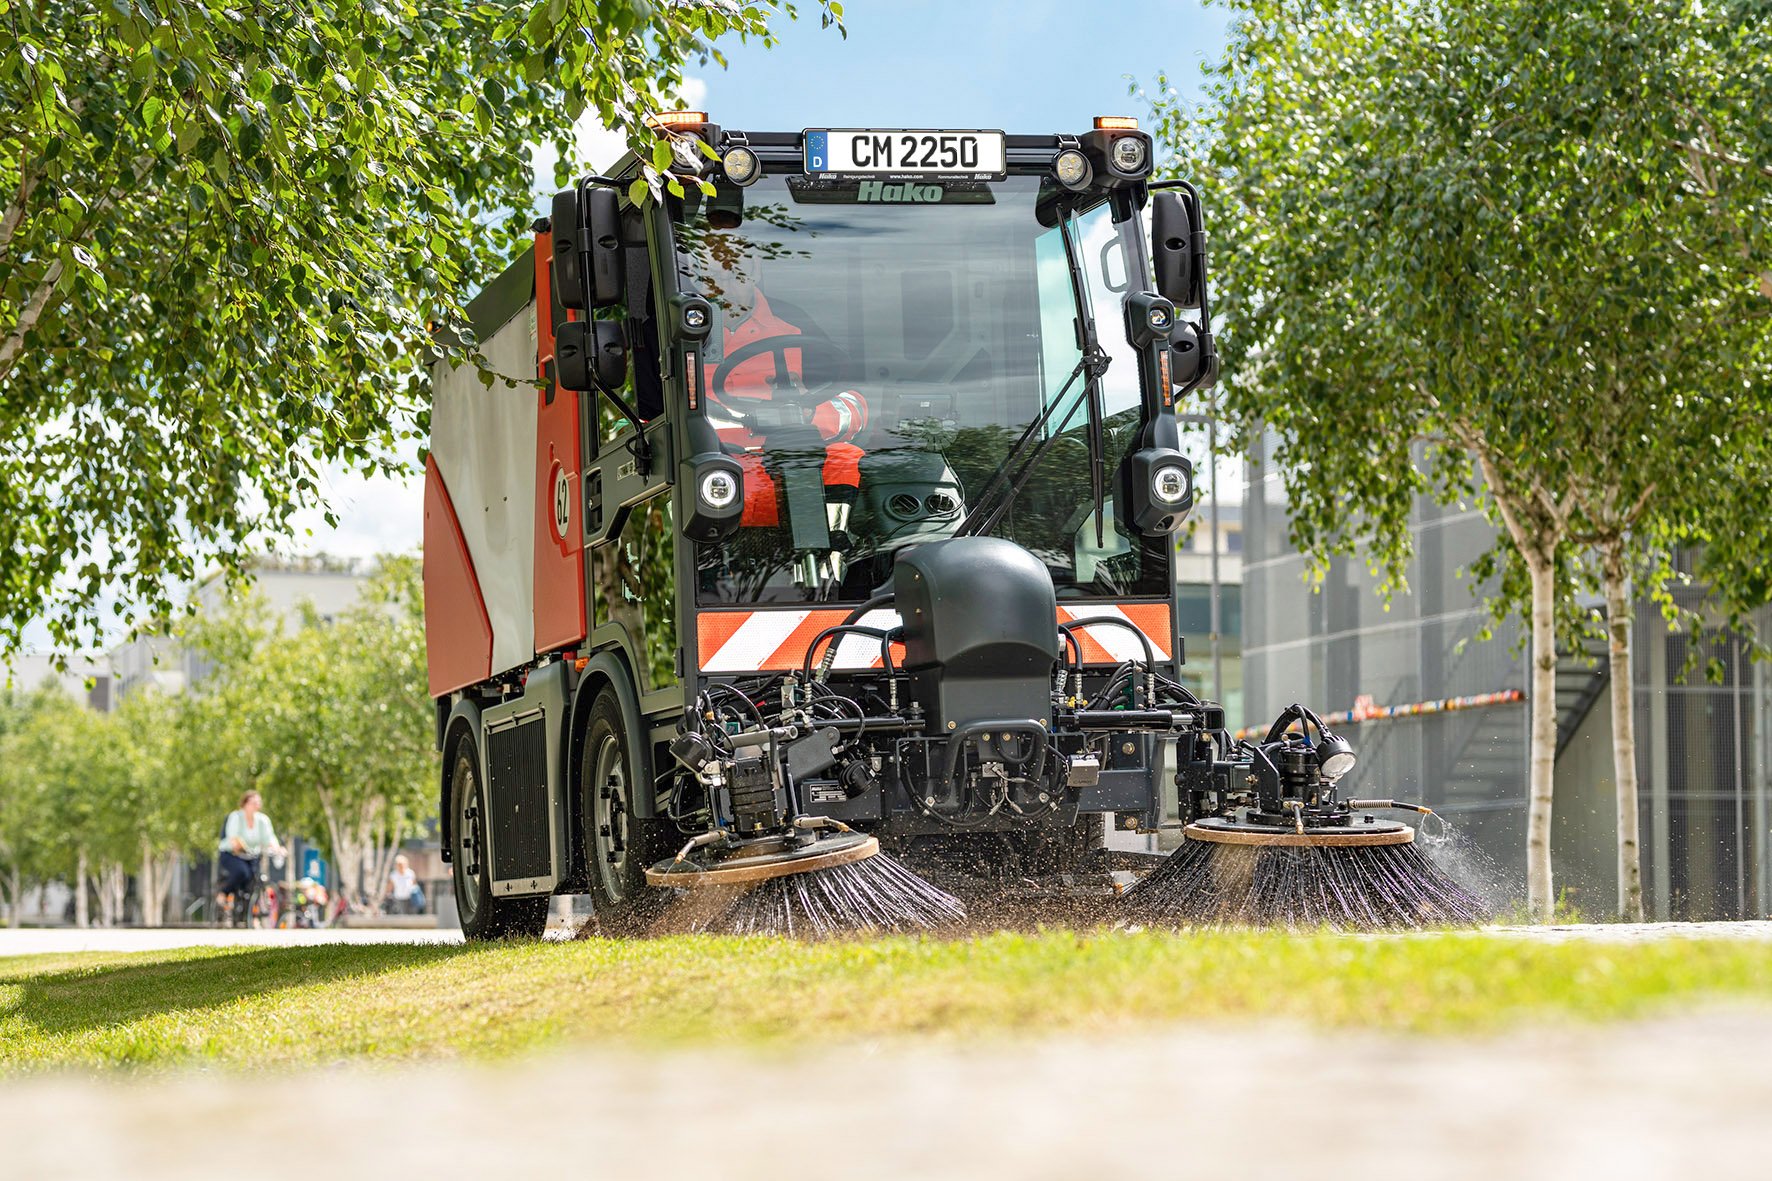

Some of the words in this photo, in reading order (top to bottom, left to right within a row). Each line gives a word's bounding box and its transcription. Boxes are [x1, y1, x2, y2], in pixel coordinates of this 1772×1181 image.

[813, 156, 823, 168] D
[851, 135, 893, 168] CM
[900, 135, 979, 168] 2250
[857, 181, 944, 202] Hako
[557, 478, 568, 526] 62
